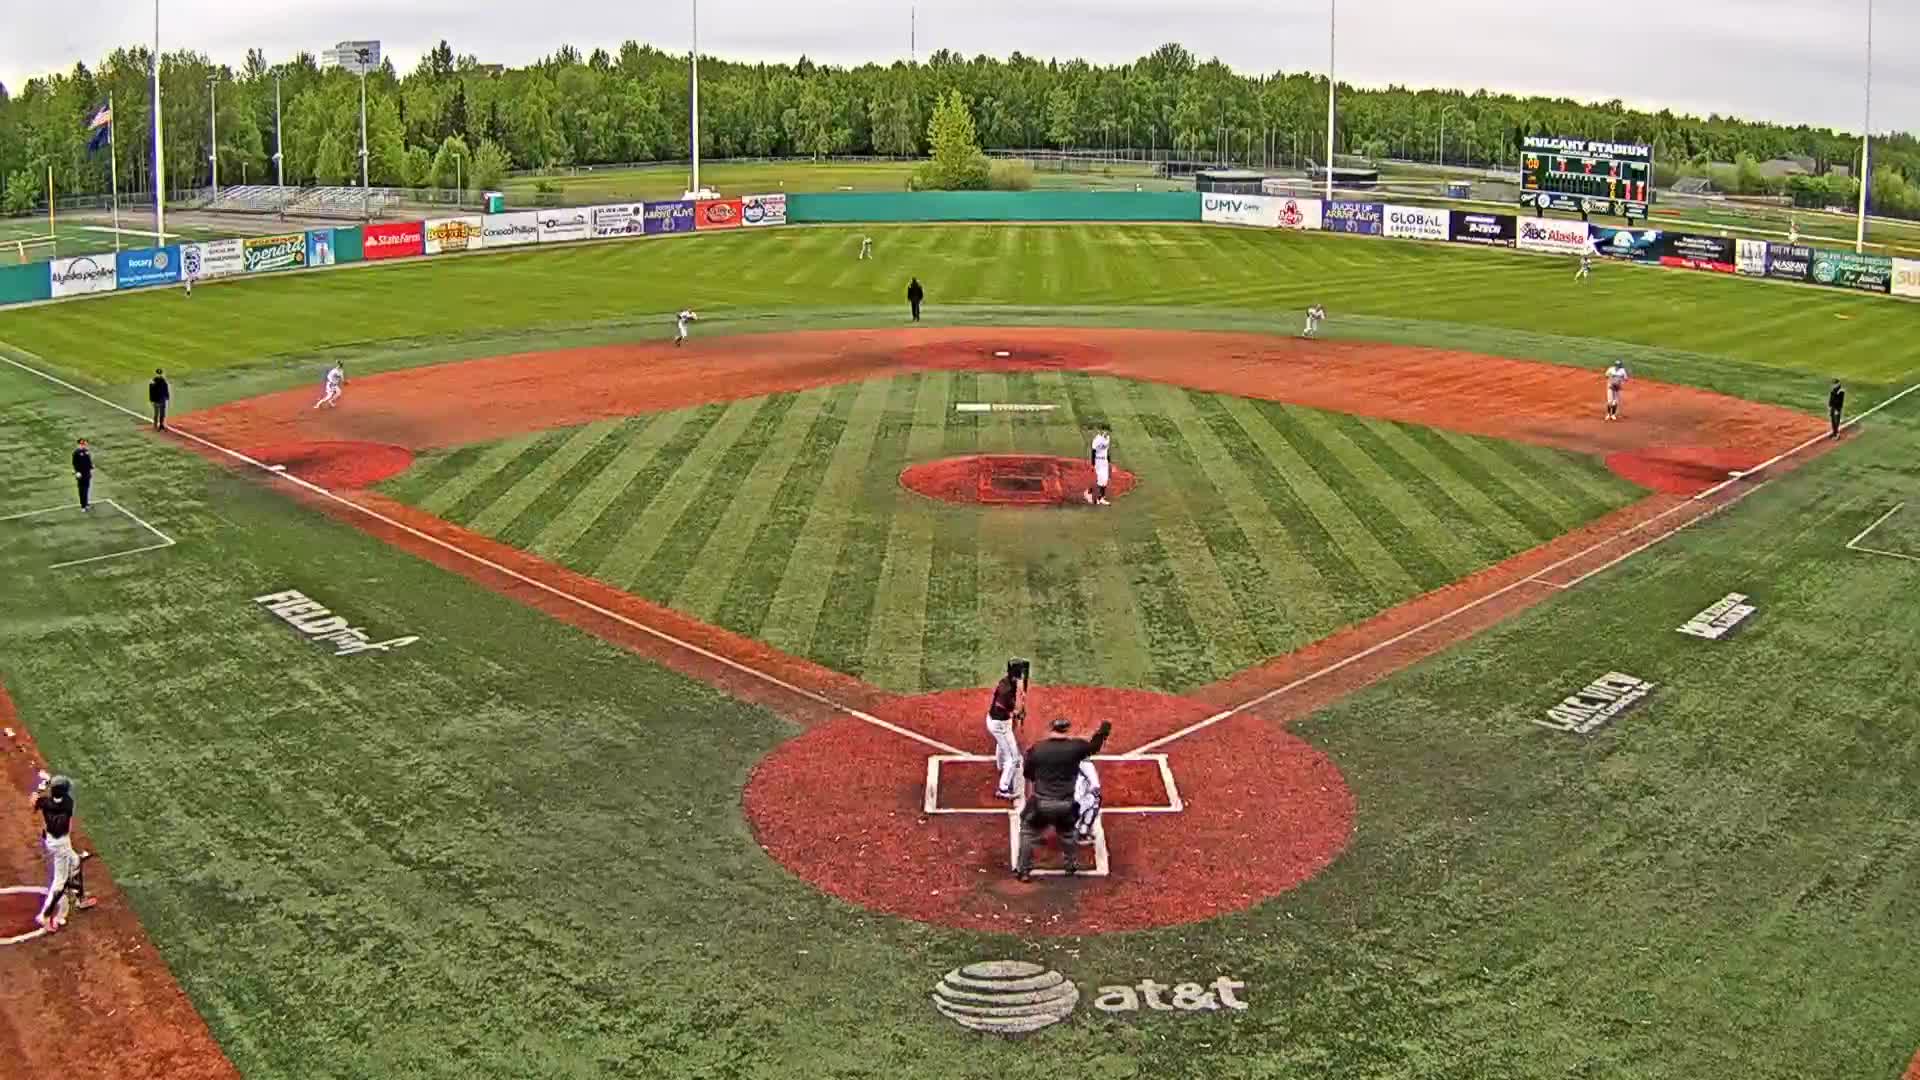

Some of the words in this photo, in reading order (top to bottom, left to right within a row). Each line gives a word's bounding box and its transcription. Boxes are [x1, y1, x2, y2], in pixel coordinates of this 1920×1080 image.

[1524, 137, 1585, 152] MULCAHY
[1588, 142, 1648, 157] STADIUM
[1391, 212, 1441, 227] GLOBAL
[483, 224, 538, 237] ConocoPhillips
[1521, 227, 1547, 241] ABC
[1548, 230, 1585, 245] Alaska
[128, 259, 152, 269] Rotary
[1094, 976, 1248, 1012] at&t
